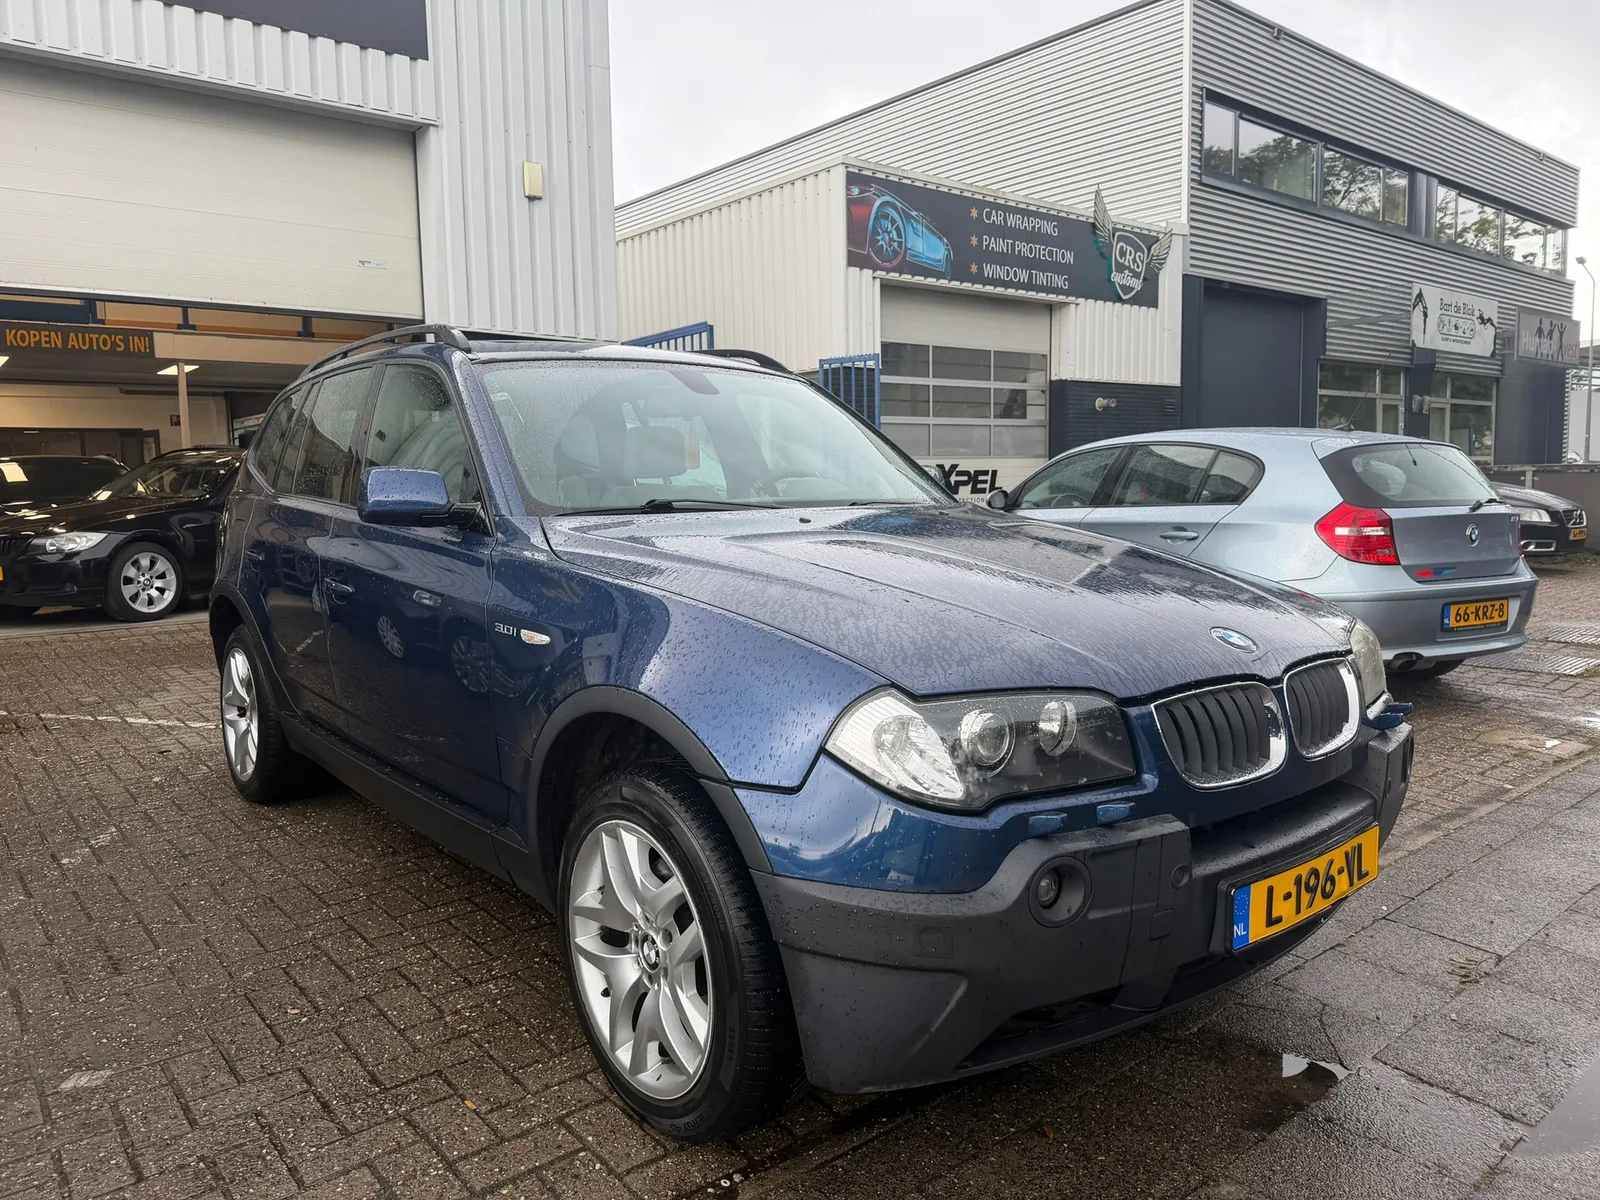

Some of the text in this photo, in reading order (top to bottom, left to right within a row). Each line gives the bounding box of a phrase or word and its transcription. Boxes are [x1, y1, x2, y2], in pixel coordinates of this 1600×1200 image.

[983, 208, 1058, 236] CAR WRAPPING
[982, 235, 1074, 265] PAINT PROTECTION
[1116, 242, 1143, 272] CRS
[983, 262, 1068, 289] WINDOW TINTING
[5, 329, 150, 353] KOPEN AUTO'S IN!
[935, 463, 1003, 495] XPEL
[1455, 602, 1505, 623] 66-KRZ-8
[1233, 922, 1247, 938] NL
